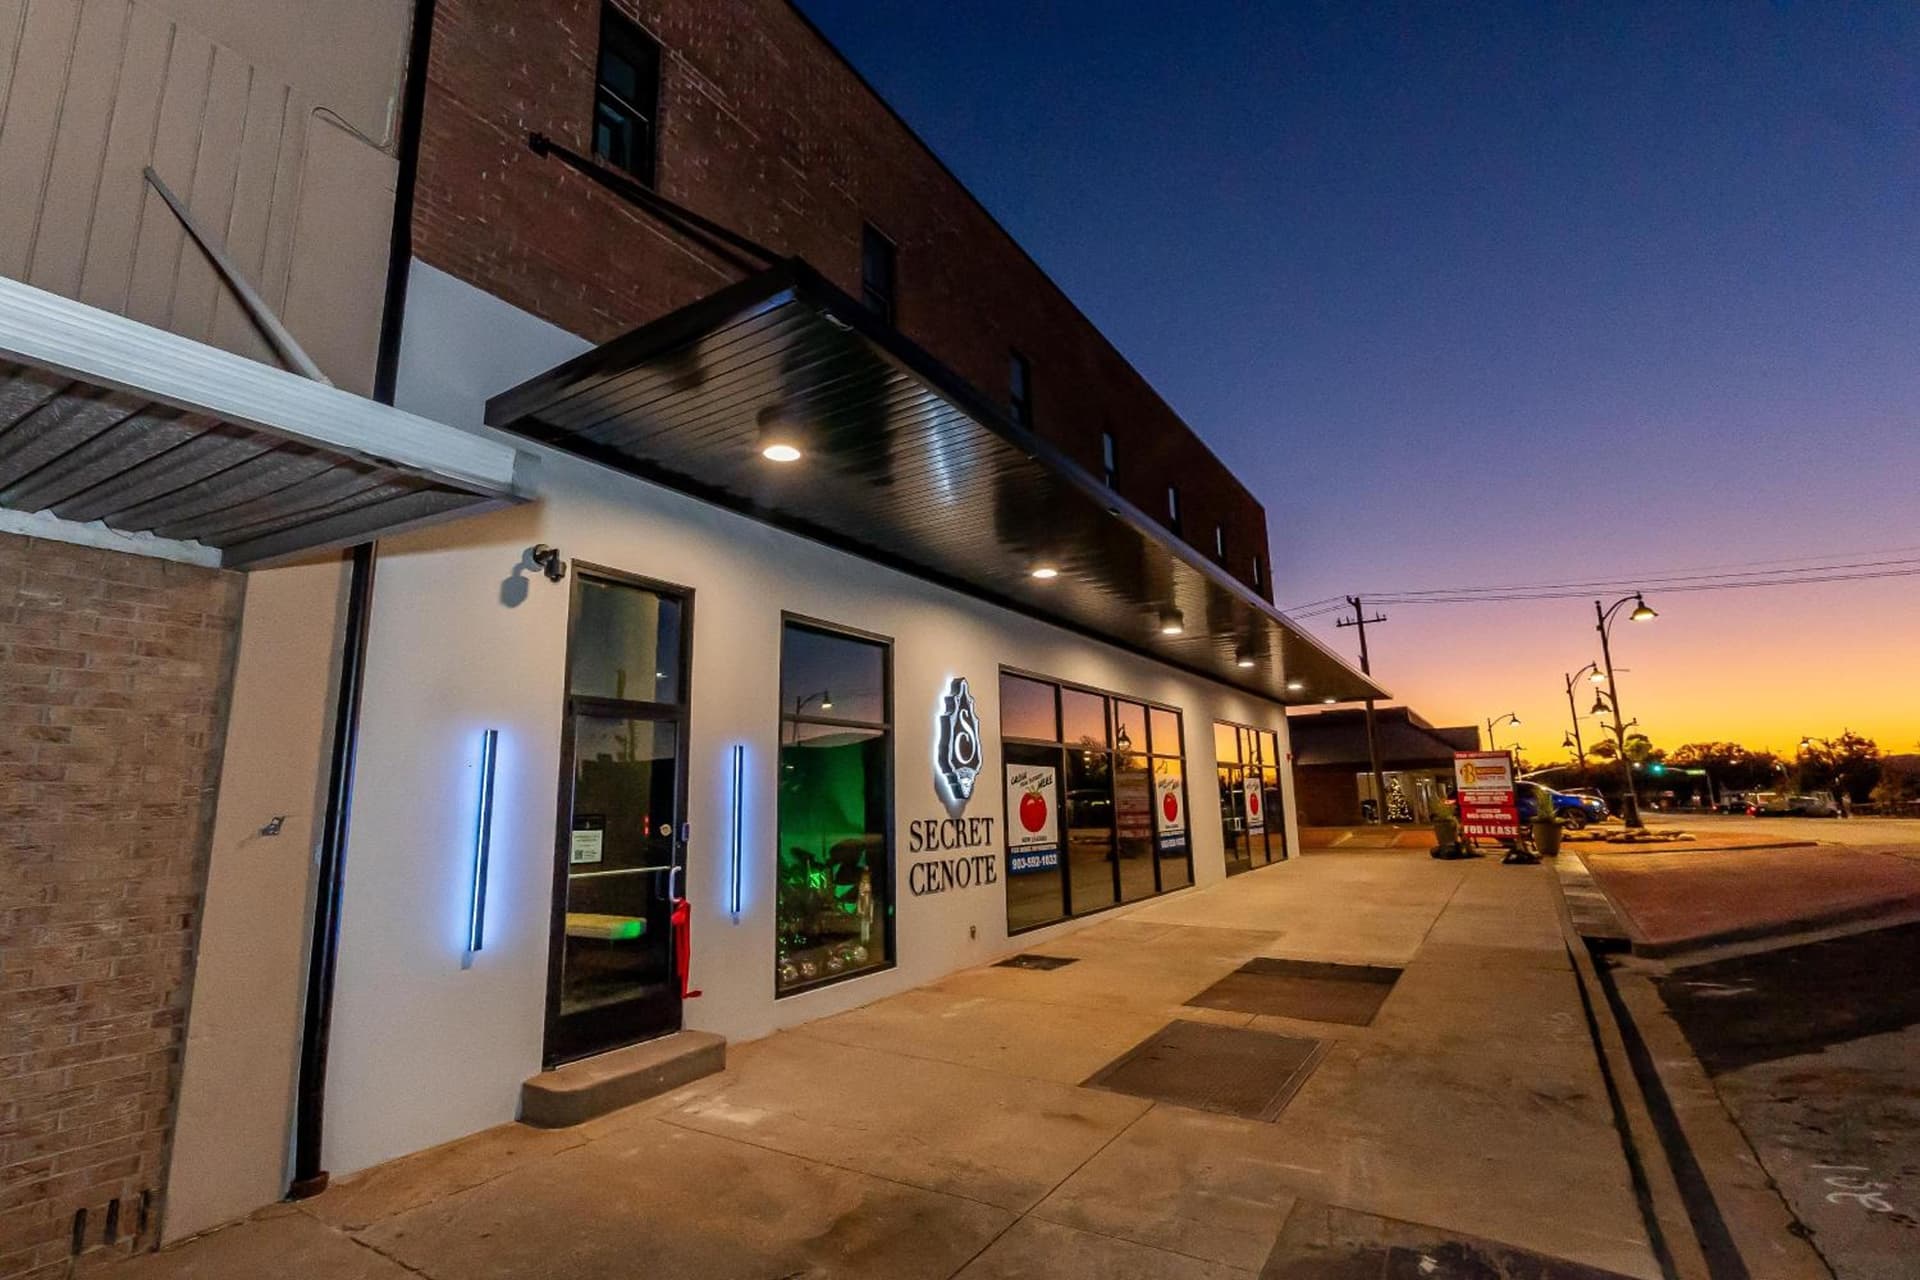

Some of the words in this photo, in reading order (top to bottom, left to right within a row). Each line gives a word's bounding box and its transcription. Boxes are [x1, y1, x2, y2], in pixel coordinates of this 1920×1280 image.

[910, 817, 994, 853] SECRET
[1463, 825, 1483, 834] FOR
[1485, 825, 1519, 835] LEASE
[909, 855, 997, 897] CENOTE
